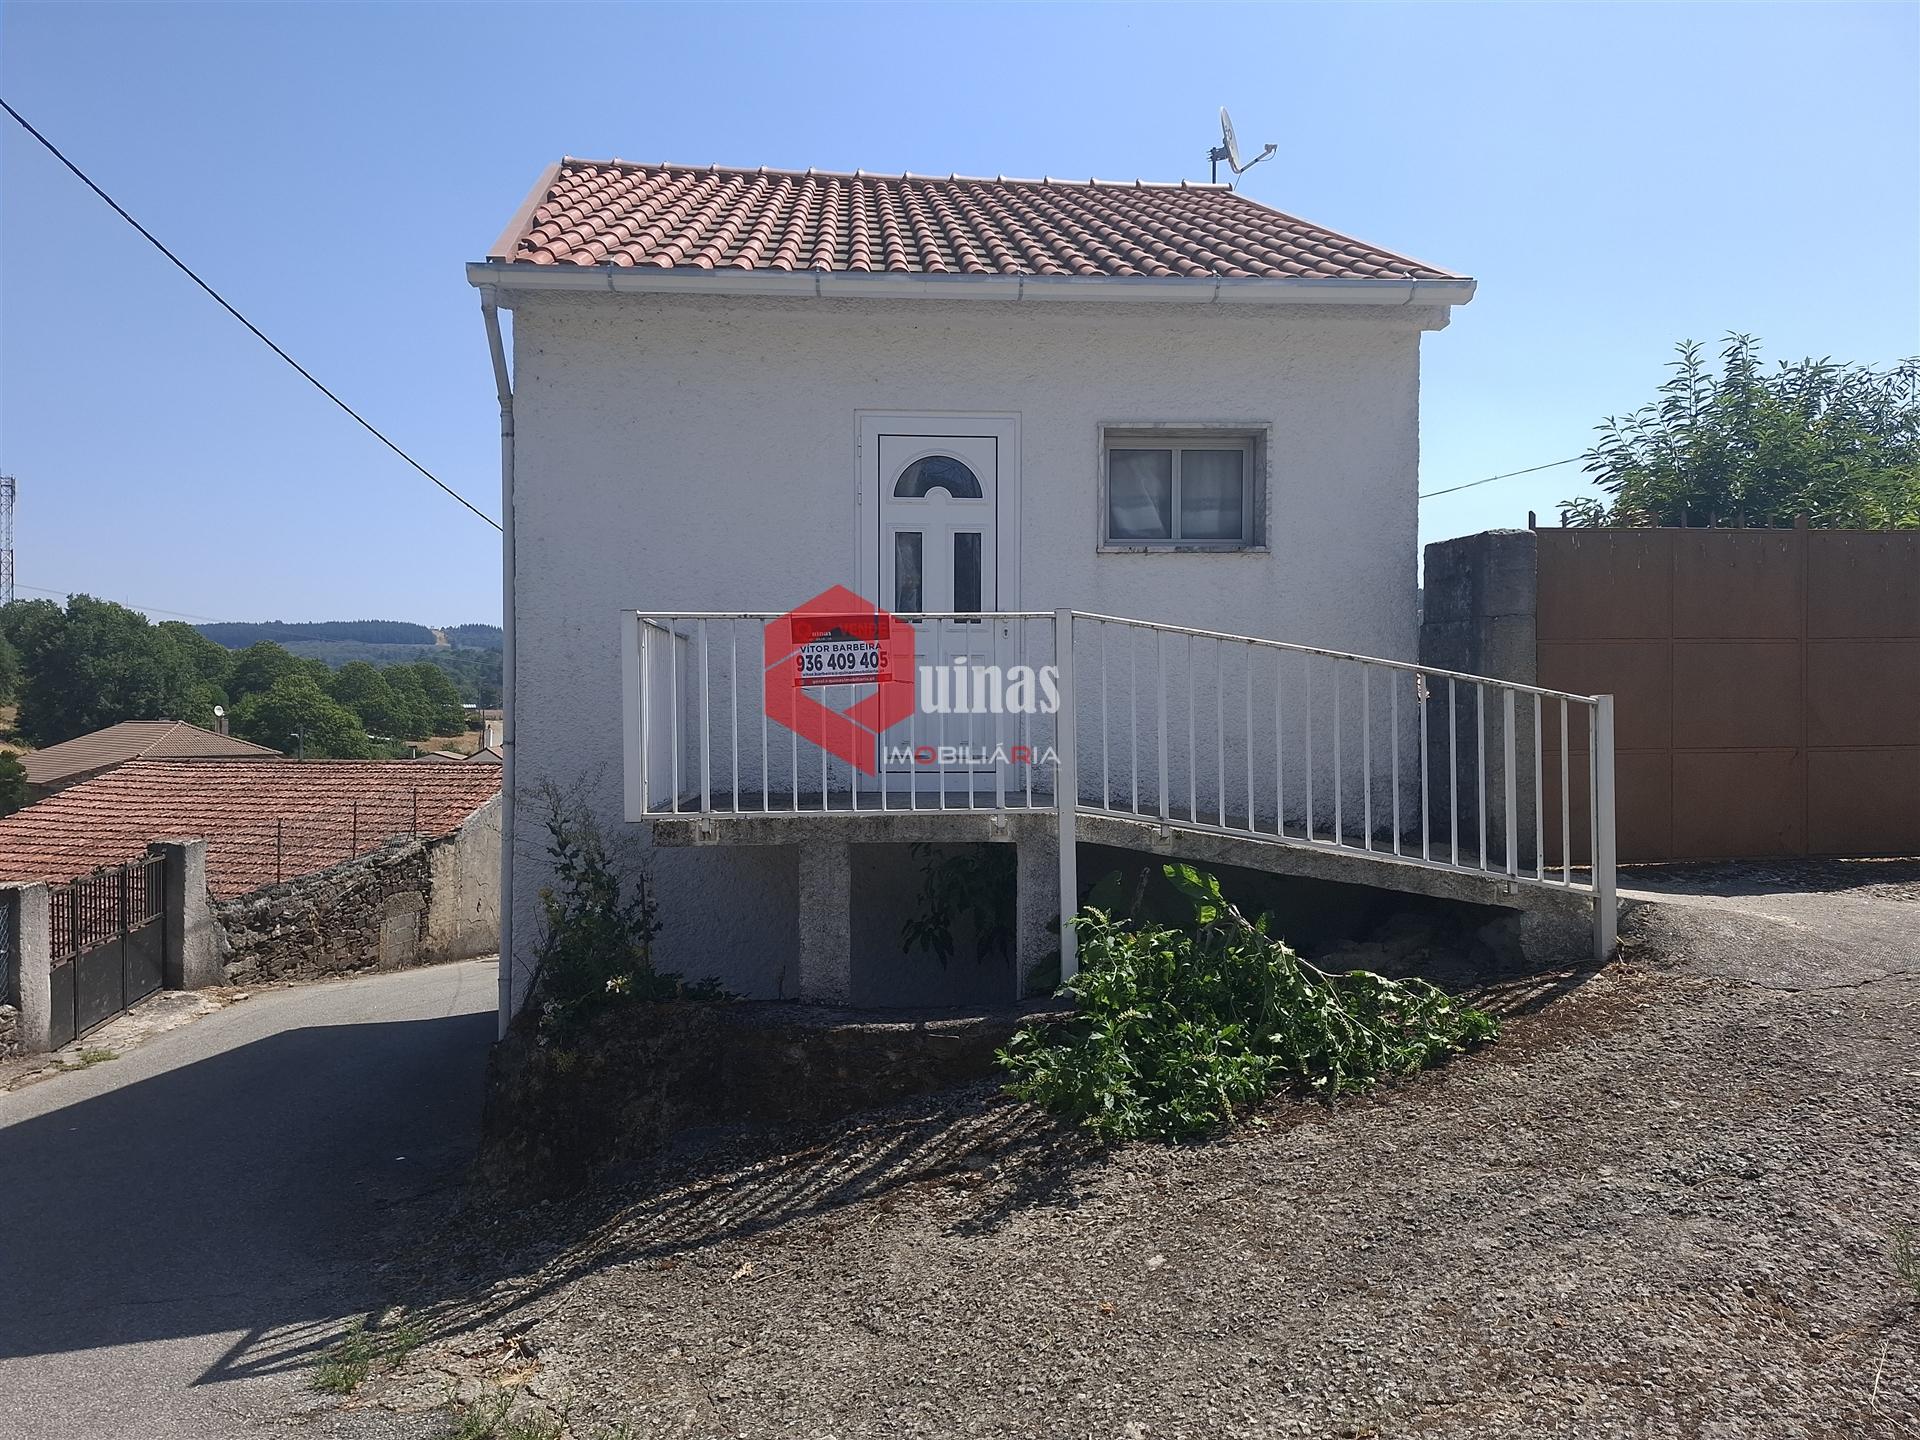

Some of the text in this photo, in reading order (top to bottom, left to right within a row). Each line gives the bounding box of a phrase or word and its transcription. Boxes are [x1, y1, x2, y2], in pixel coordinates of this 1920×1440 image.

[800, 643, 882, 653] VÍTOR BARBEIRA
[796, 651, 888, 672] 936 409 405
